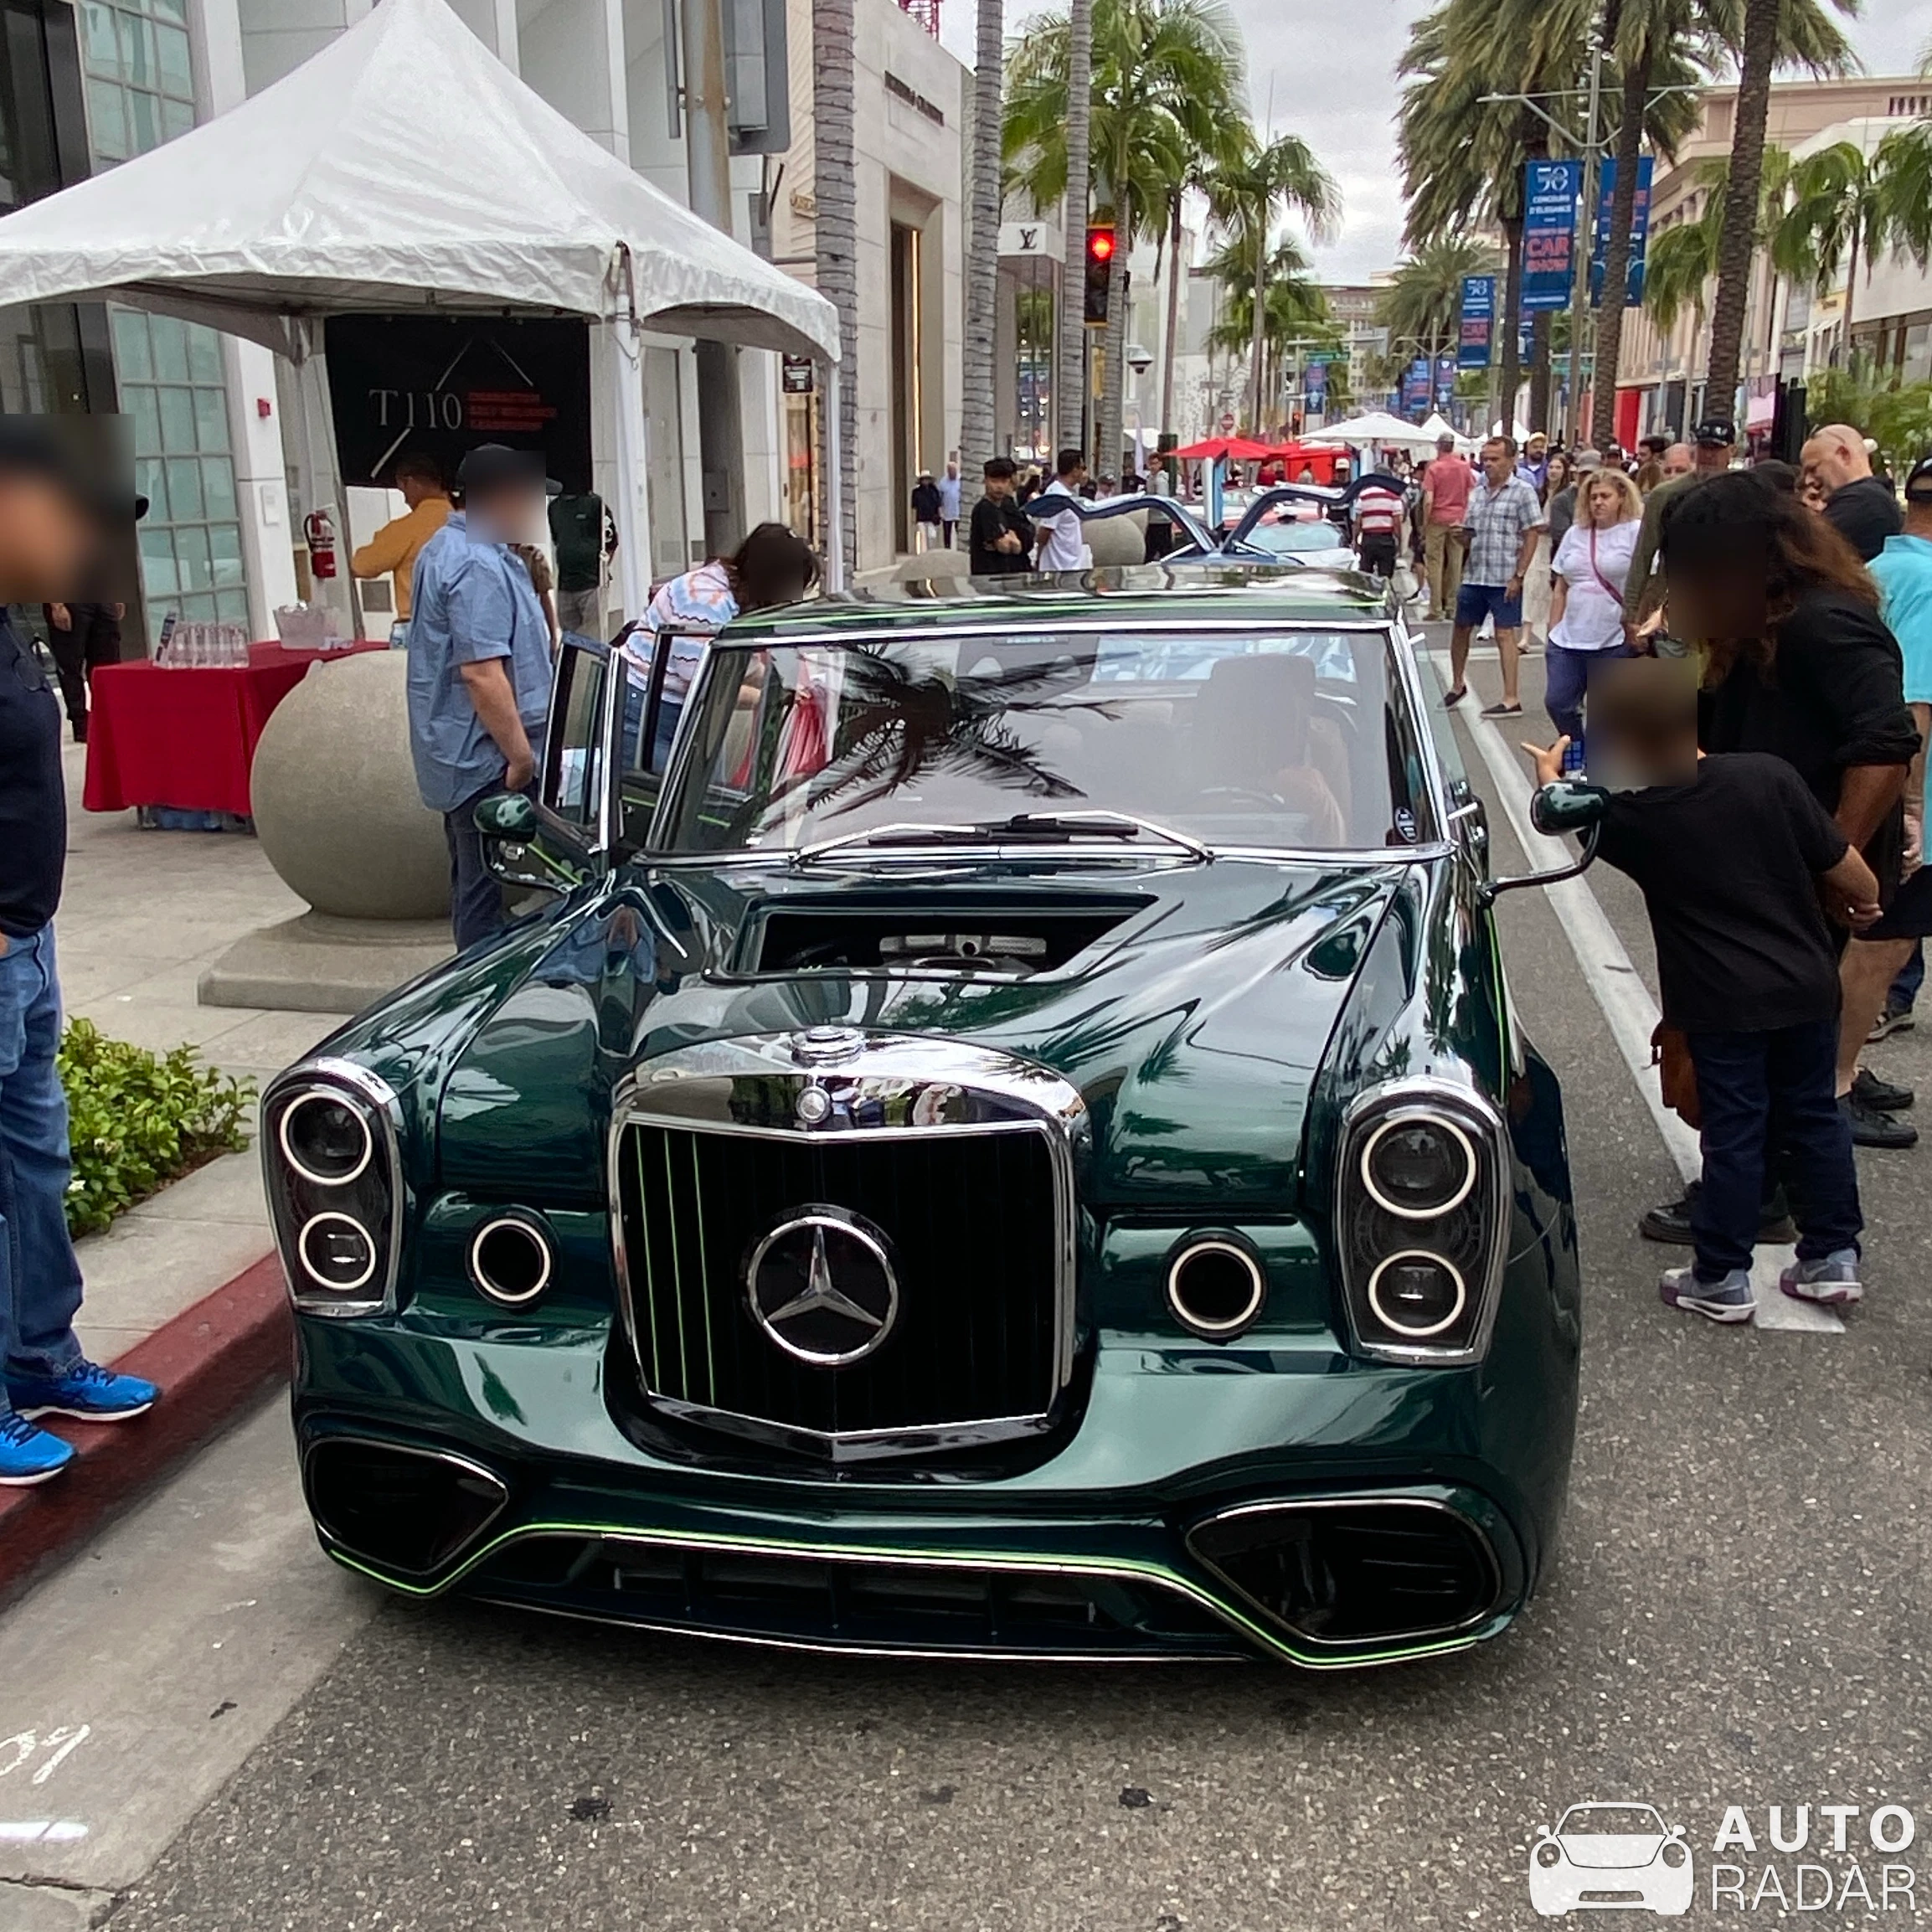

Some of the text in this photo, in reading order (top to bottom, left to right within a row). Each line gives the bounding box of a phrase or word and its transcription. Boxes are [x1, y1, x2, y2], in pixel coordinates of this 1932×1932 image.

[1526, 236, 1569, 257] CAR
[1525, 258, 1568, 274] SHOW
[368, 389, 461, 430] T110
